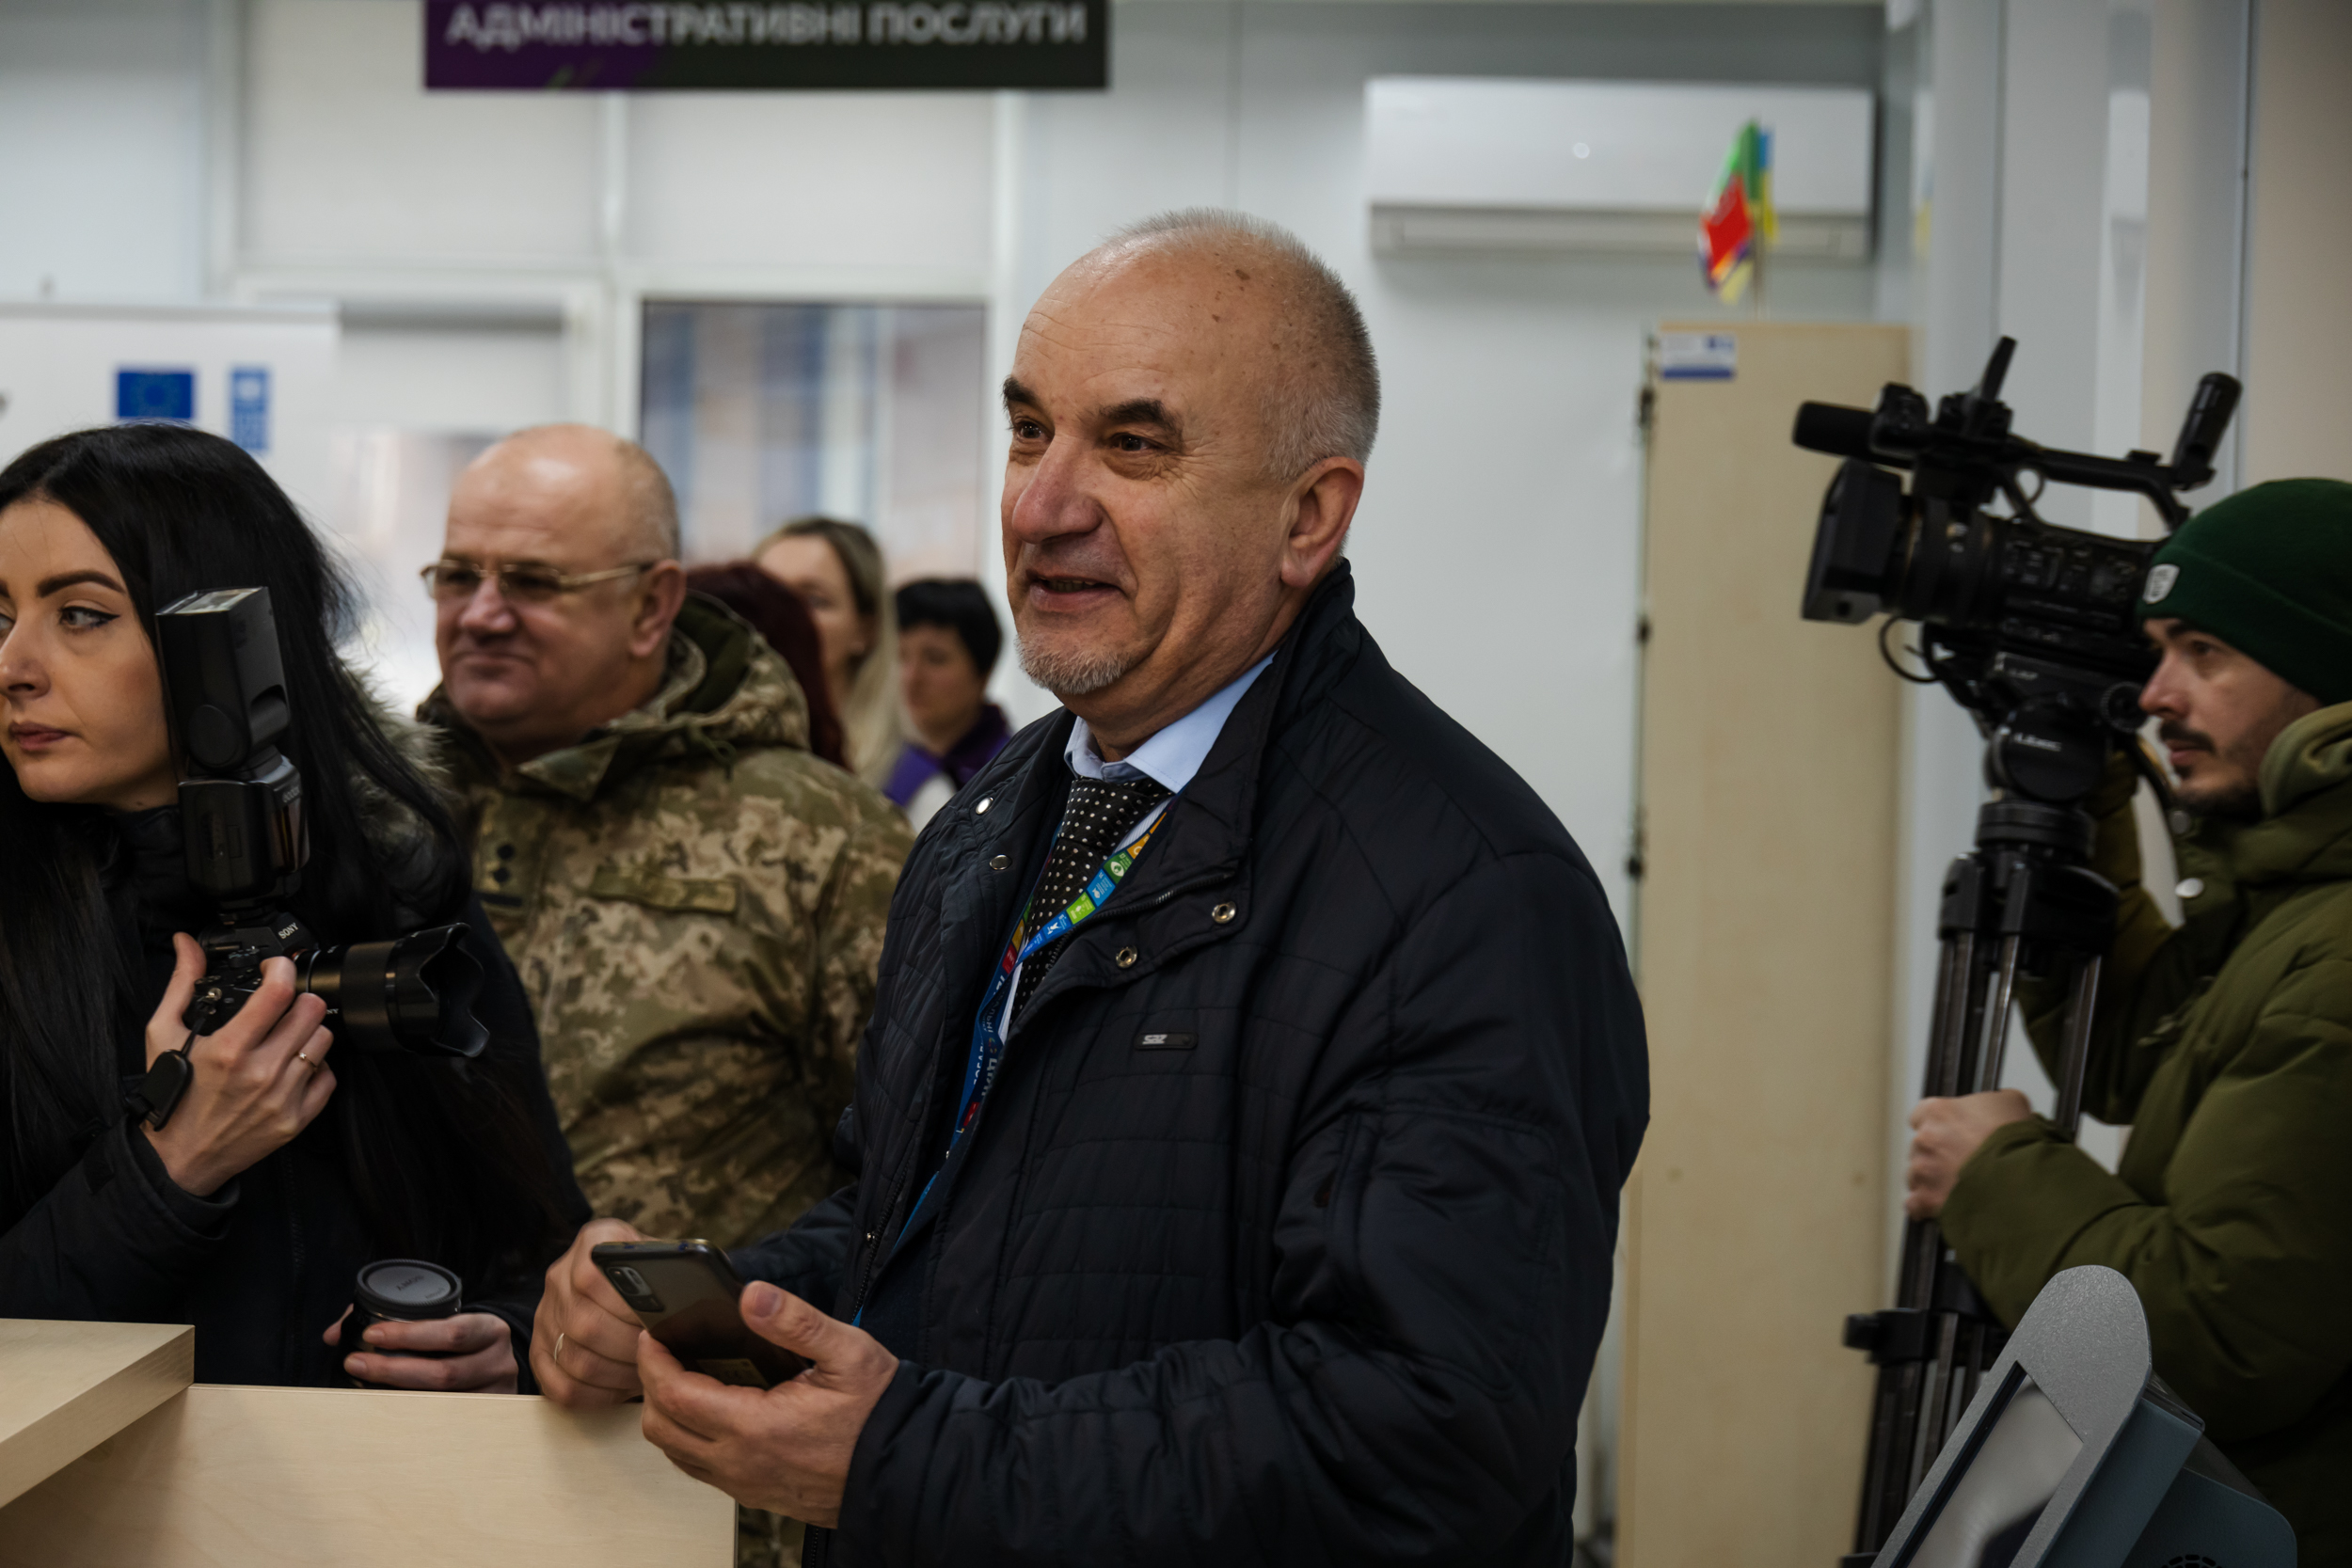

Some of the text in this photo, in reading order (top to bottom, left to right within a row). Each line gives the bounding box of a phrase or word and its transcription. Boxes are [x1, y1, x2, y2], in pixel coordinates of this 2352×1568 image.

[443, 2, 1088, 53] АДМІНІСТРАТИВНІ ПОСЛУГИ
[278, 922, 298, 939] SONY
